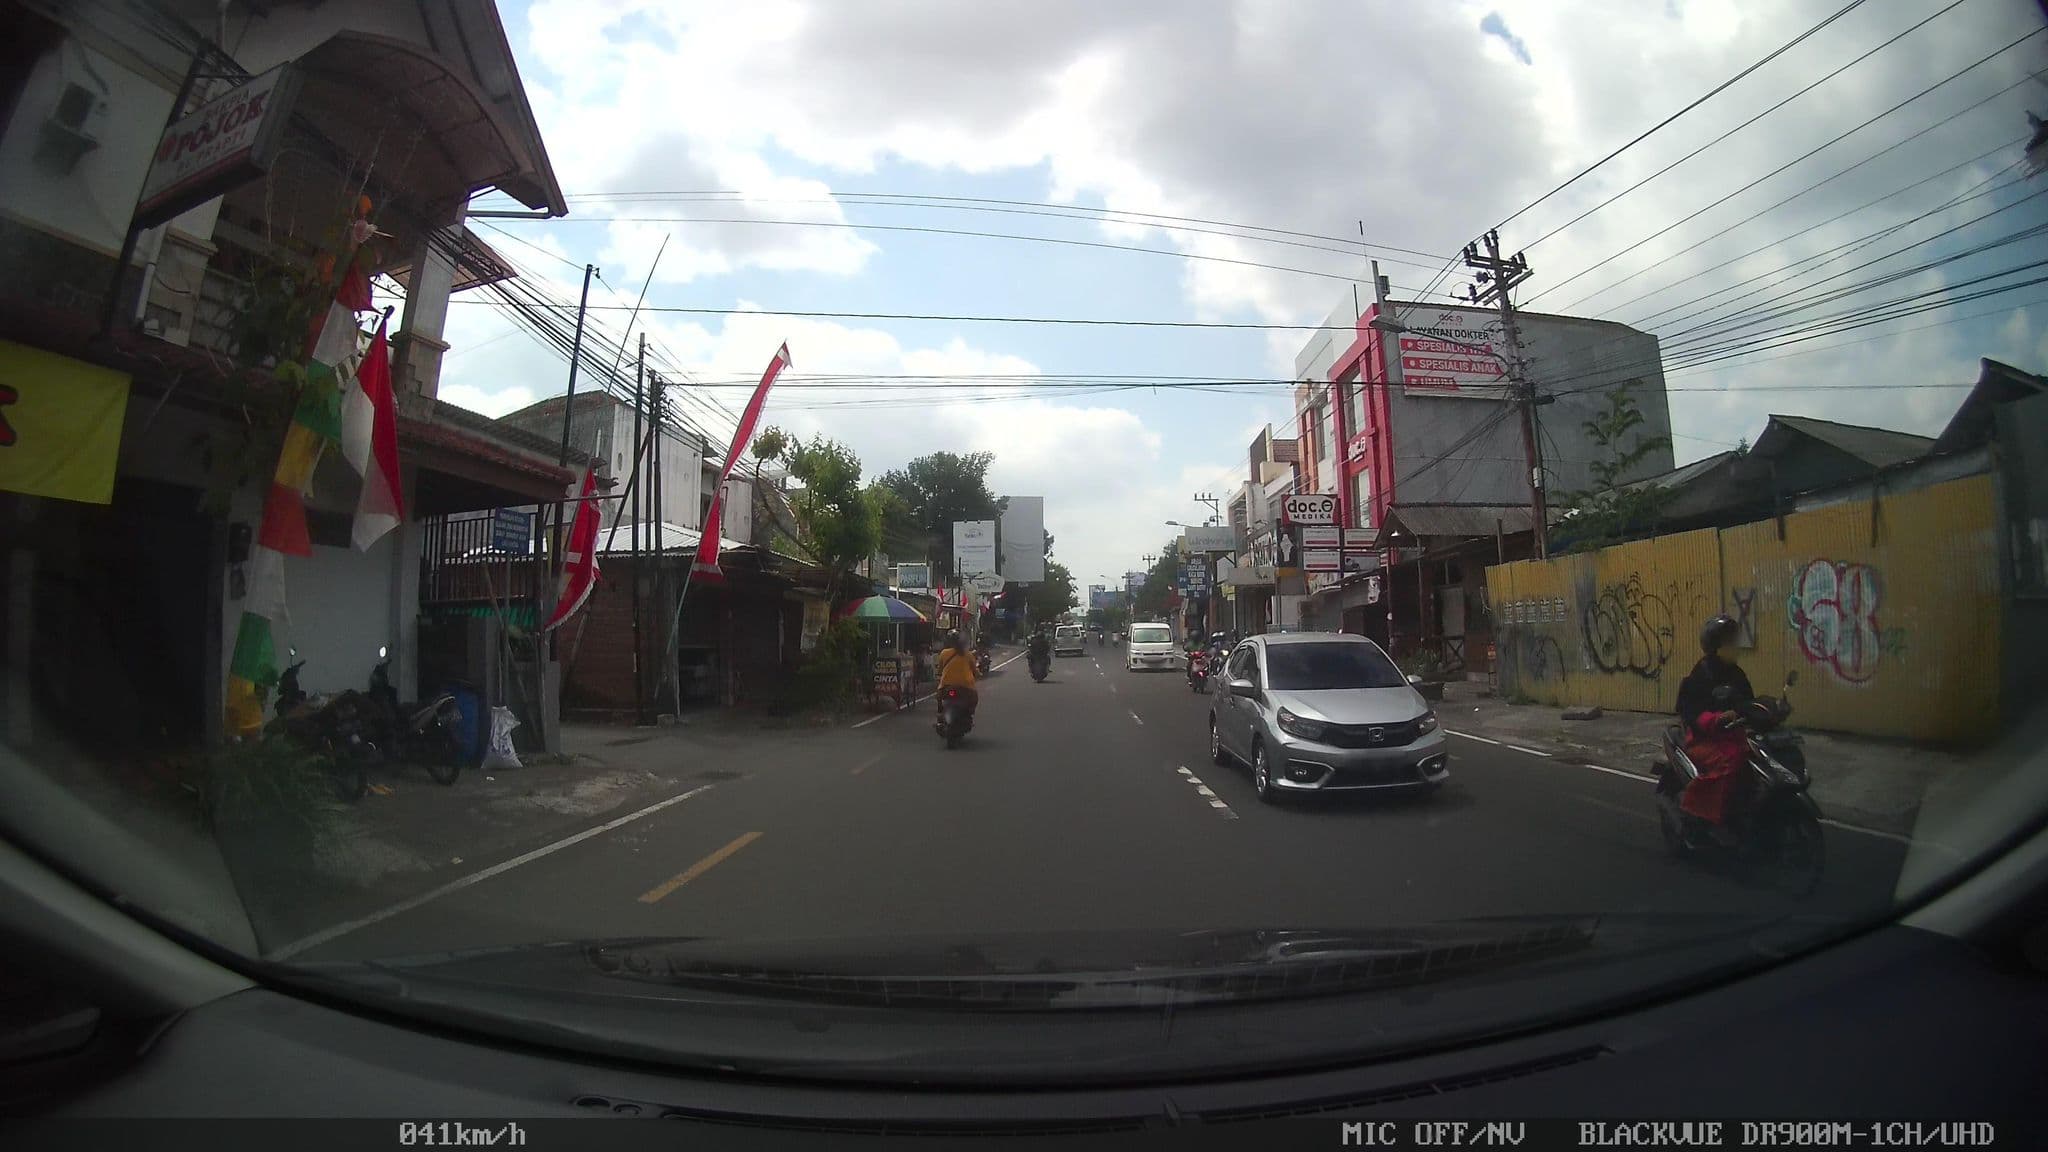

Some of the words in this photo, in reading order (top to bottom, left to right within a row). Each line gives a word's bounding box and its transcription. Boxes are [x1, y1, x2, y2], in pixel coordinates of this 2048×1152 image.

[174, 89, 272, 162] POJOK
[1416, 340, 1467, 354] SPESIALIS
[1419, 359, 1469, 372] SPESIALIS
[1471, 362, 1498, 373] ANAK
[873, 674, 898, 683] CINTA
